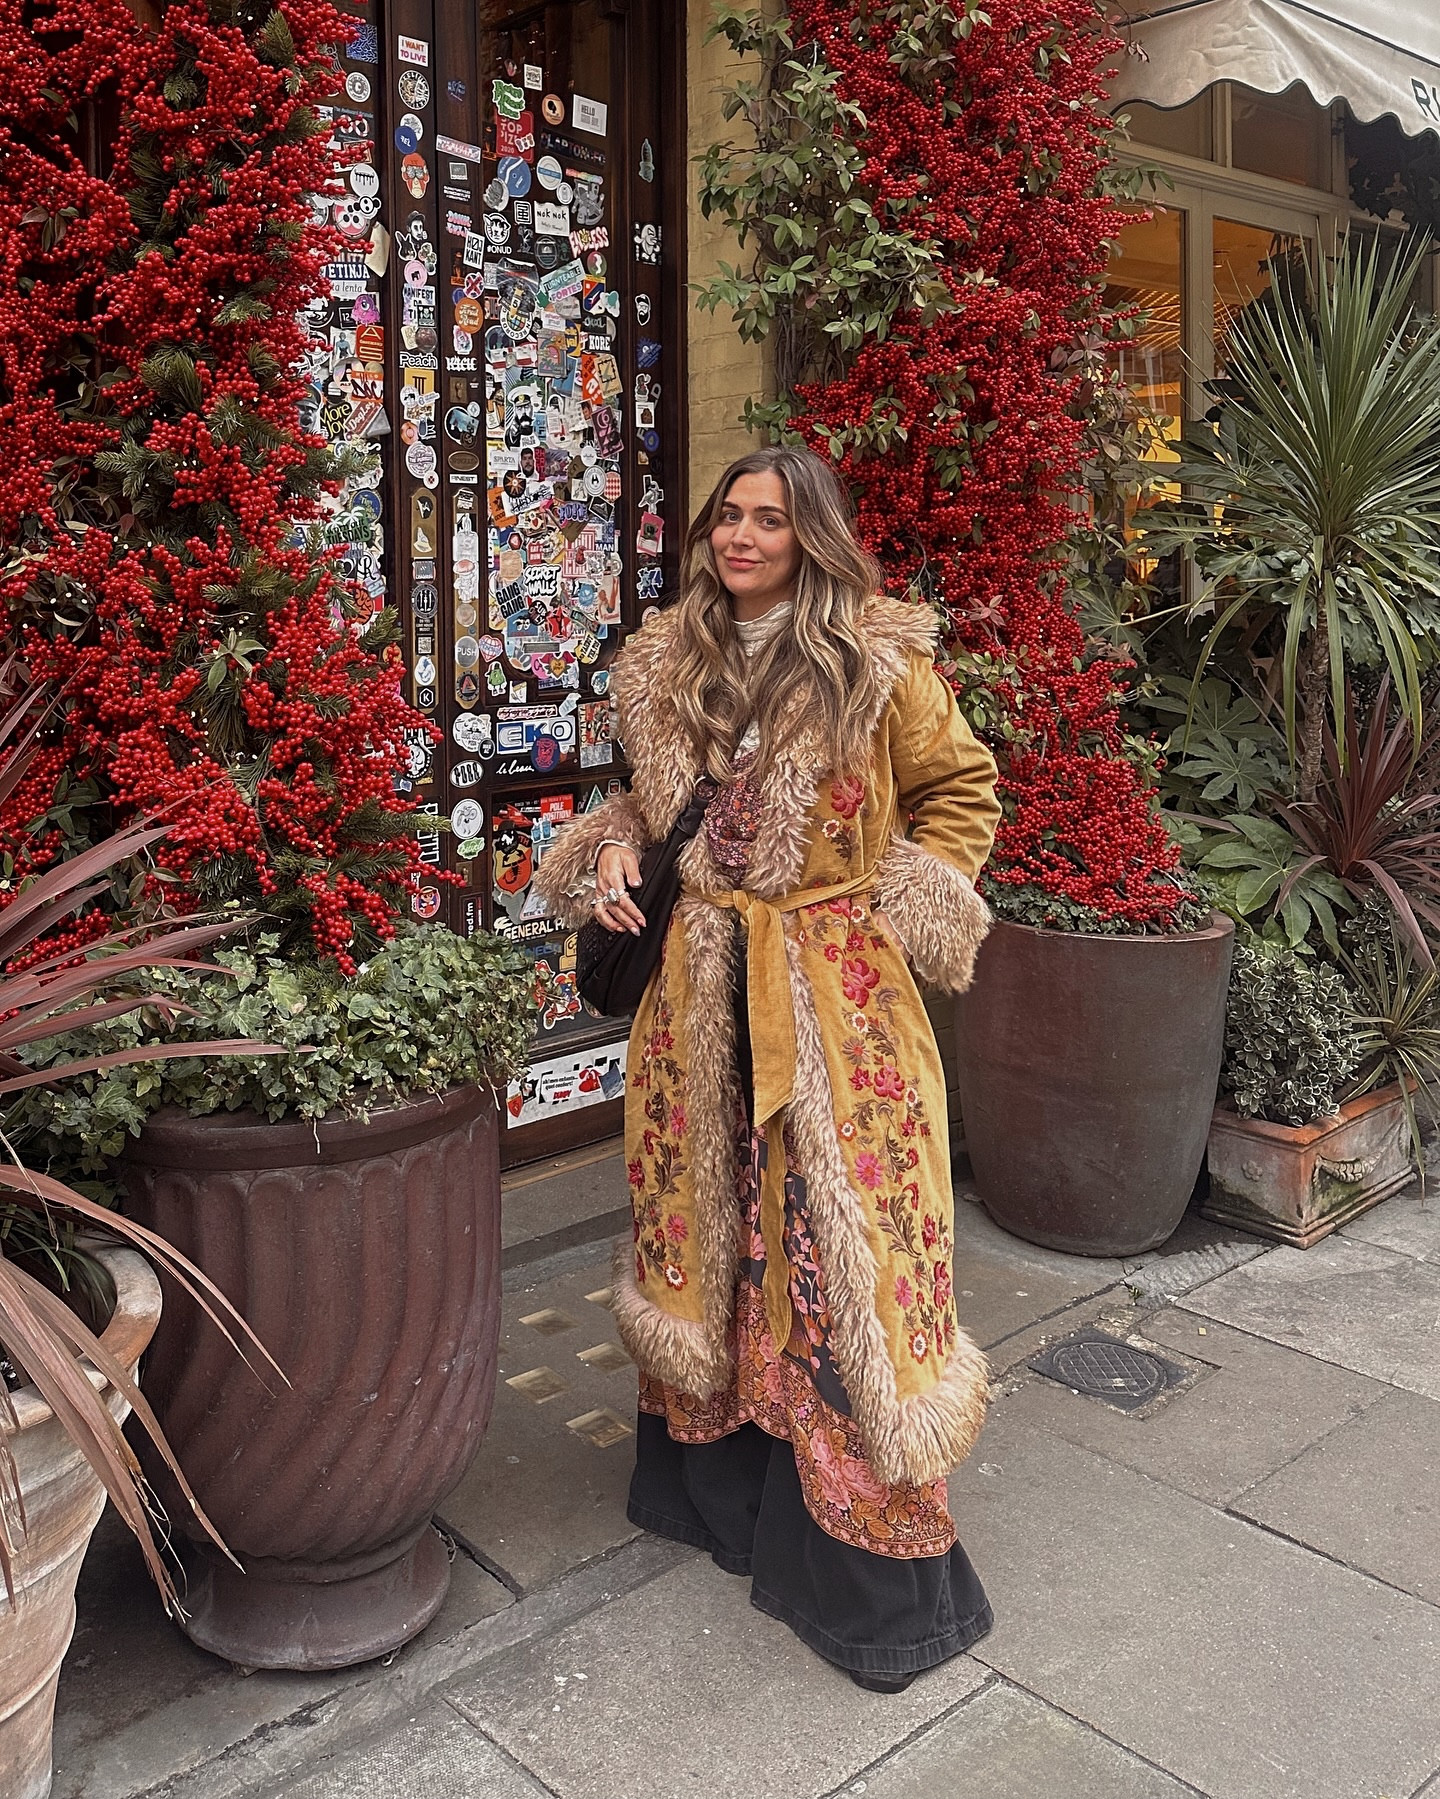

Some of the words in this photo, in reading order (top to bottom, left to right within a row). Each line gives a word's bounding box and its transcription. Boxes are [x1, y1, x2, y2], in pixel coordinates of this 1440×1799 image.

[405, 40, 425, 52] WANT
[400, 49, 410, 58] TO
[410, 51, 427, 63] LIVE
[500, 122, 523, 134] TOP
[551, 281, 583, 302] FORTES
[588, 334, 611, 351] KORE
[400, 353, 437, 368] Peach
[326, 525, 370, 544] TUESDAYS
[595, 543, 614, 552] MAN
[525, 565, 560, 580] SECRET
[496, 582, 521, 606] GANG
[527, 580, 558, 597] WALLS
[500, 595, 526, 619] GANG
[456, 647, 477, 656] PUSH
[497, 720, 572, 748] EKO
[549, 801, 565, 812] POLE
[542, 808, 573, 822] POSITION!
[503, 920, 554, 940] GENERAL
